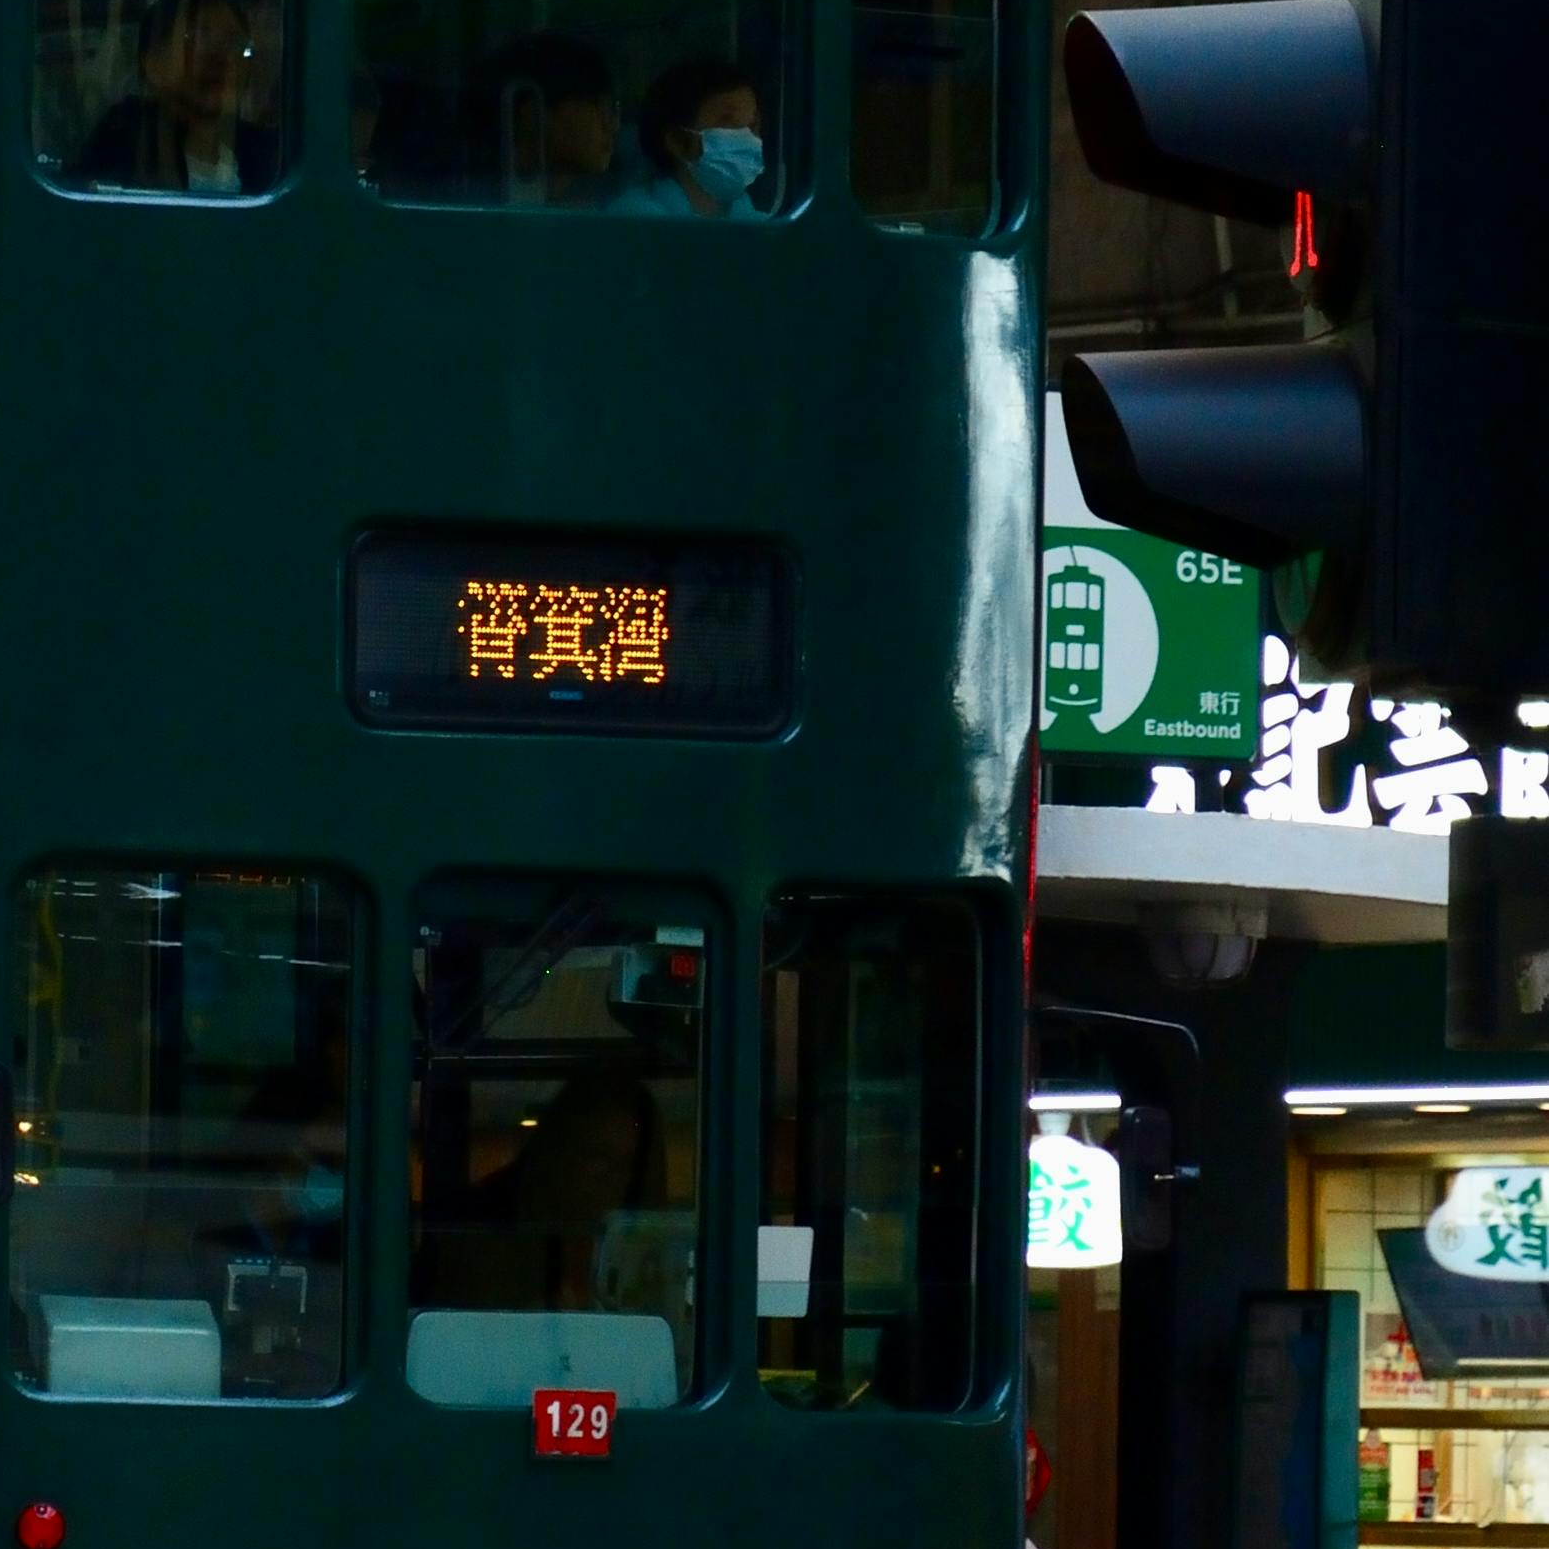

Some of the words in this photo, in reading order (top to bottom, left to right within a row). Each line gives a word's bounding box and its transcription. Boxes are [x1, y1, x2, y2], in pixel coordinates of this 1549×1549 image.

[1176, 550, 1243, 585] 65E
[1199, 691, 1241, 716] 東行
[1144, 718, 1241, 740] Eastbound
[546, 1400, 608, 1440] 129
